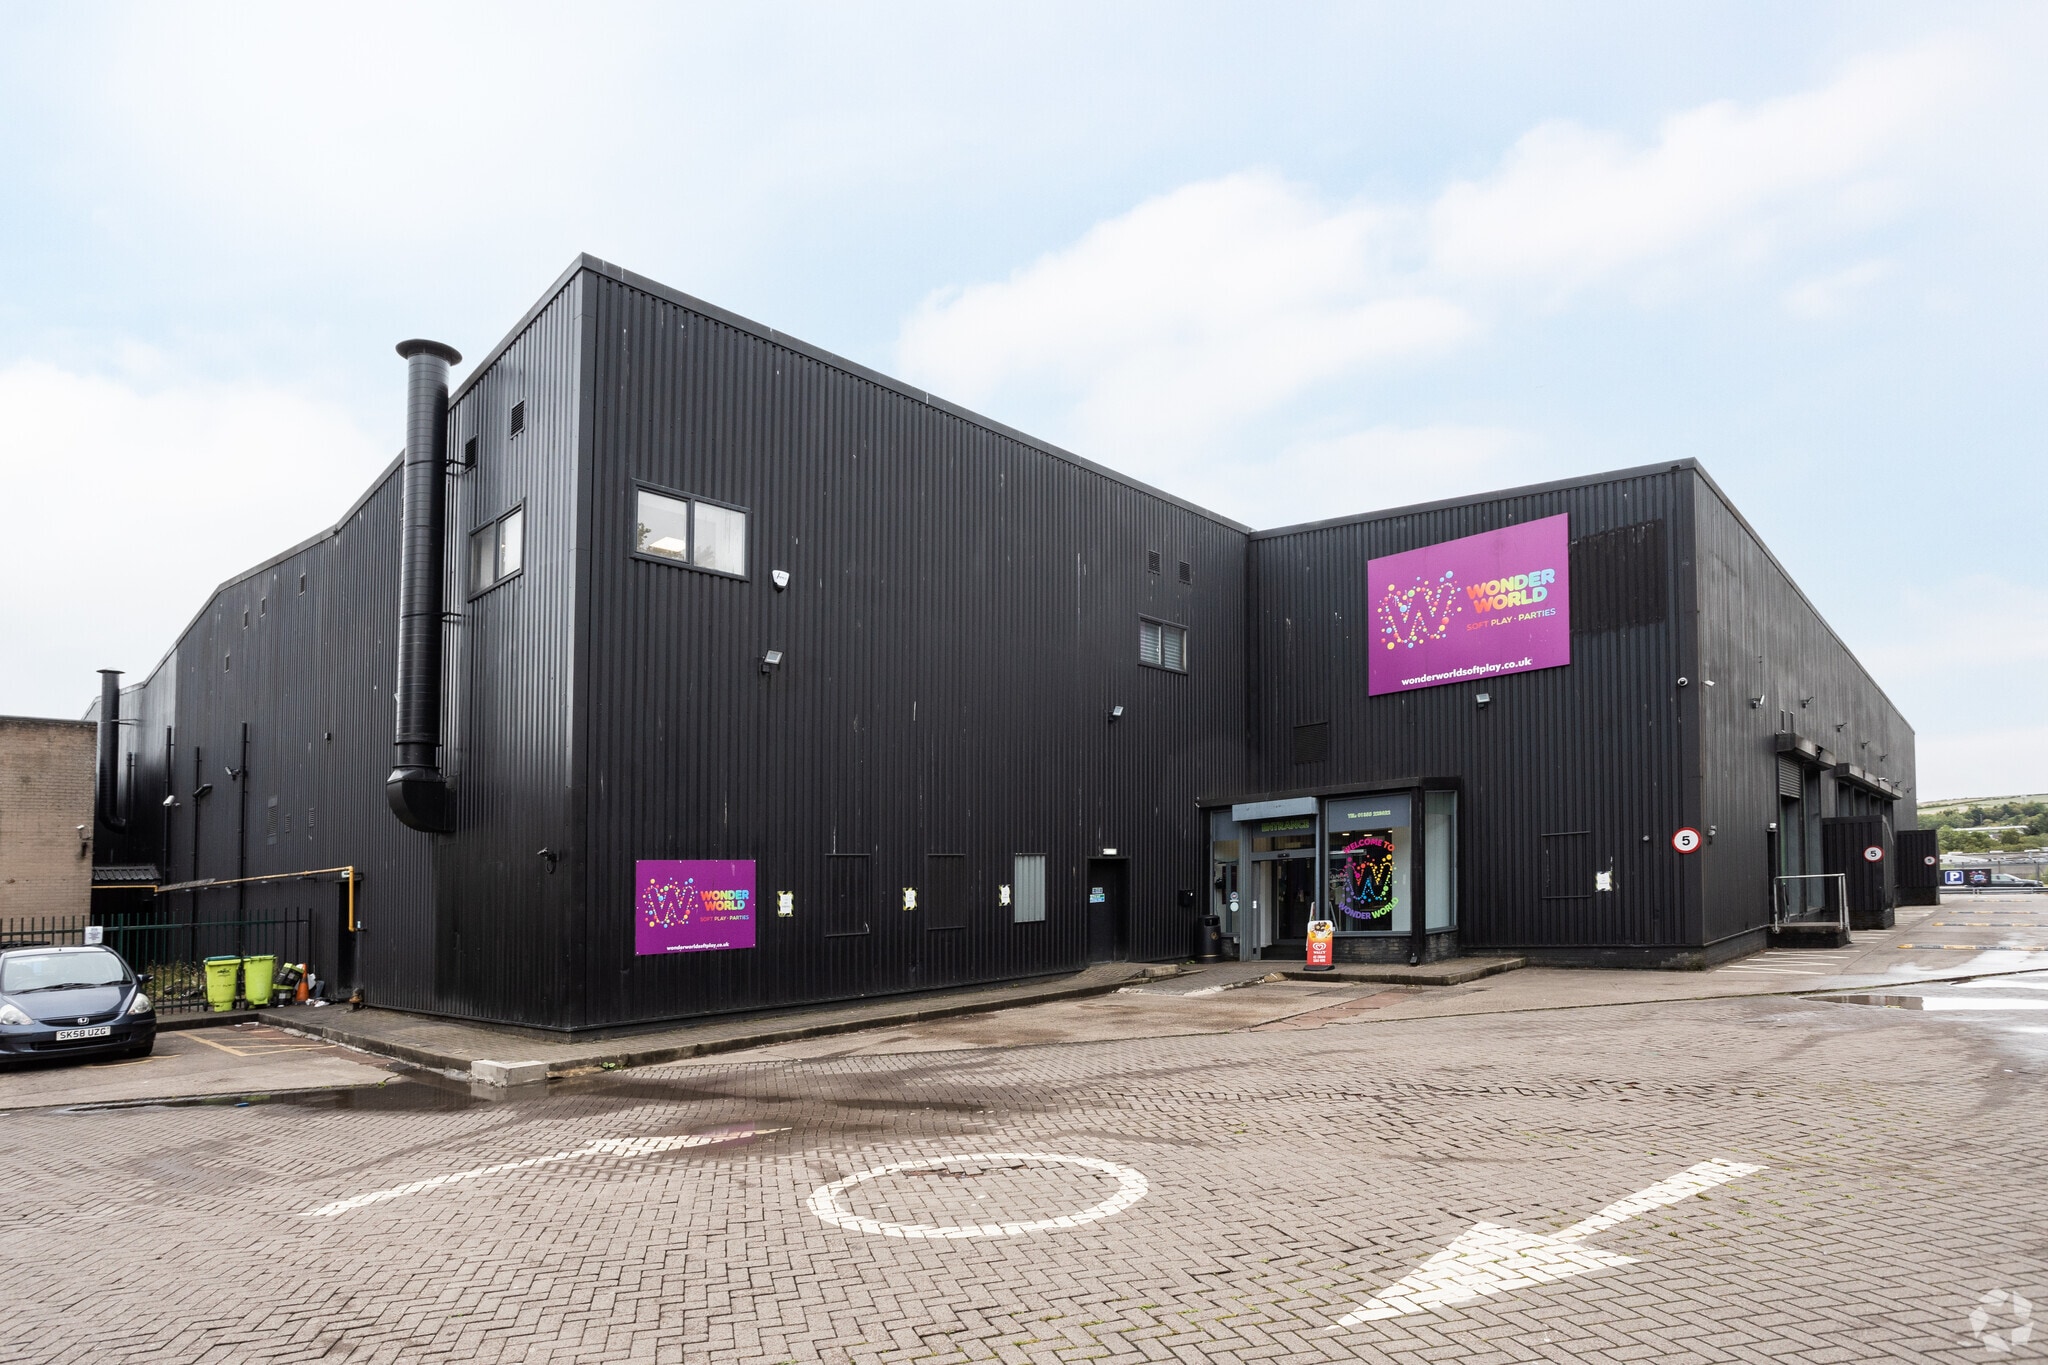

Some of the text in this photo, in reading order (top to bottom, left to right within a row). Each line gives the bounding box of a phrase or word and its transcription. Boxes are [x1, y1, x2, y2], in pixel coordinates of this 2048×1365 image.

[1466, 568, 1556, 599] WONDER
[1473, 586, 1548, 614] WORLD
[1466, 608, 1556, 631] SOFT PLAY PARTIES
[1401, 657, 1533, 686] wonderworldsoftplay.co.uk
[1261, 819, 1310, 832] ENTRANCE
[1343, 838, 1395, 854] WELCOME TO
[1682, 835, 1691, 846] 5
[1870, 850, 1877, 858] 5
[1950, 872, 1960, 882] P
[700, 889, 749, 901] WONDER
[704, 899, 746, 911] WORLD
[1338, 897, 1399, 920] WONDER WORLD
[60, 1028, 106, 1039] SK58 UZG
